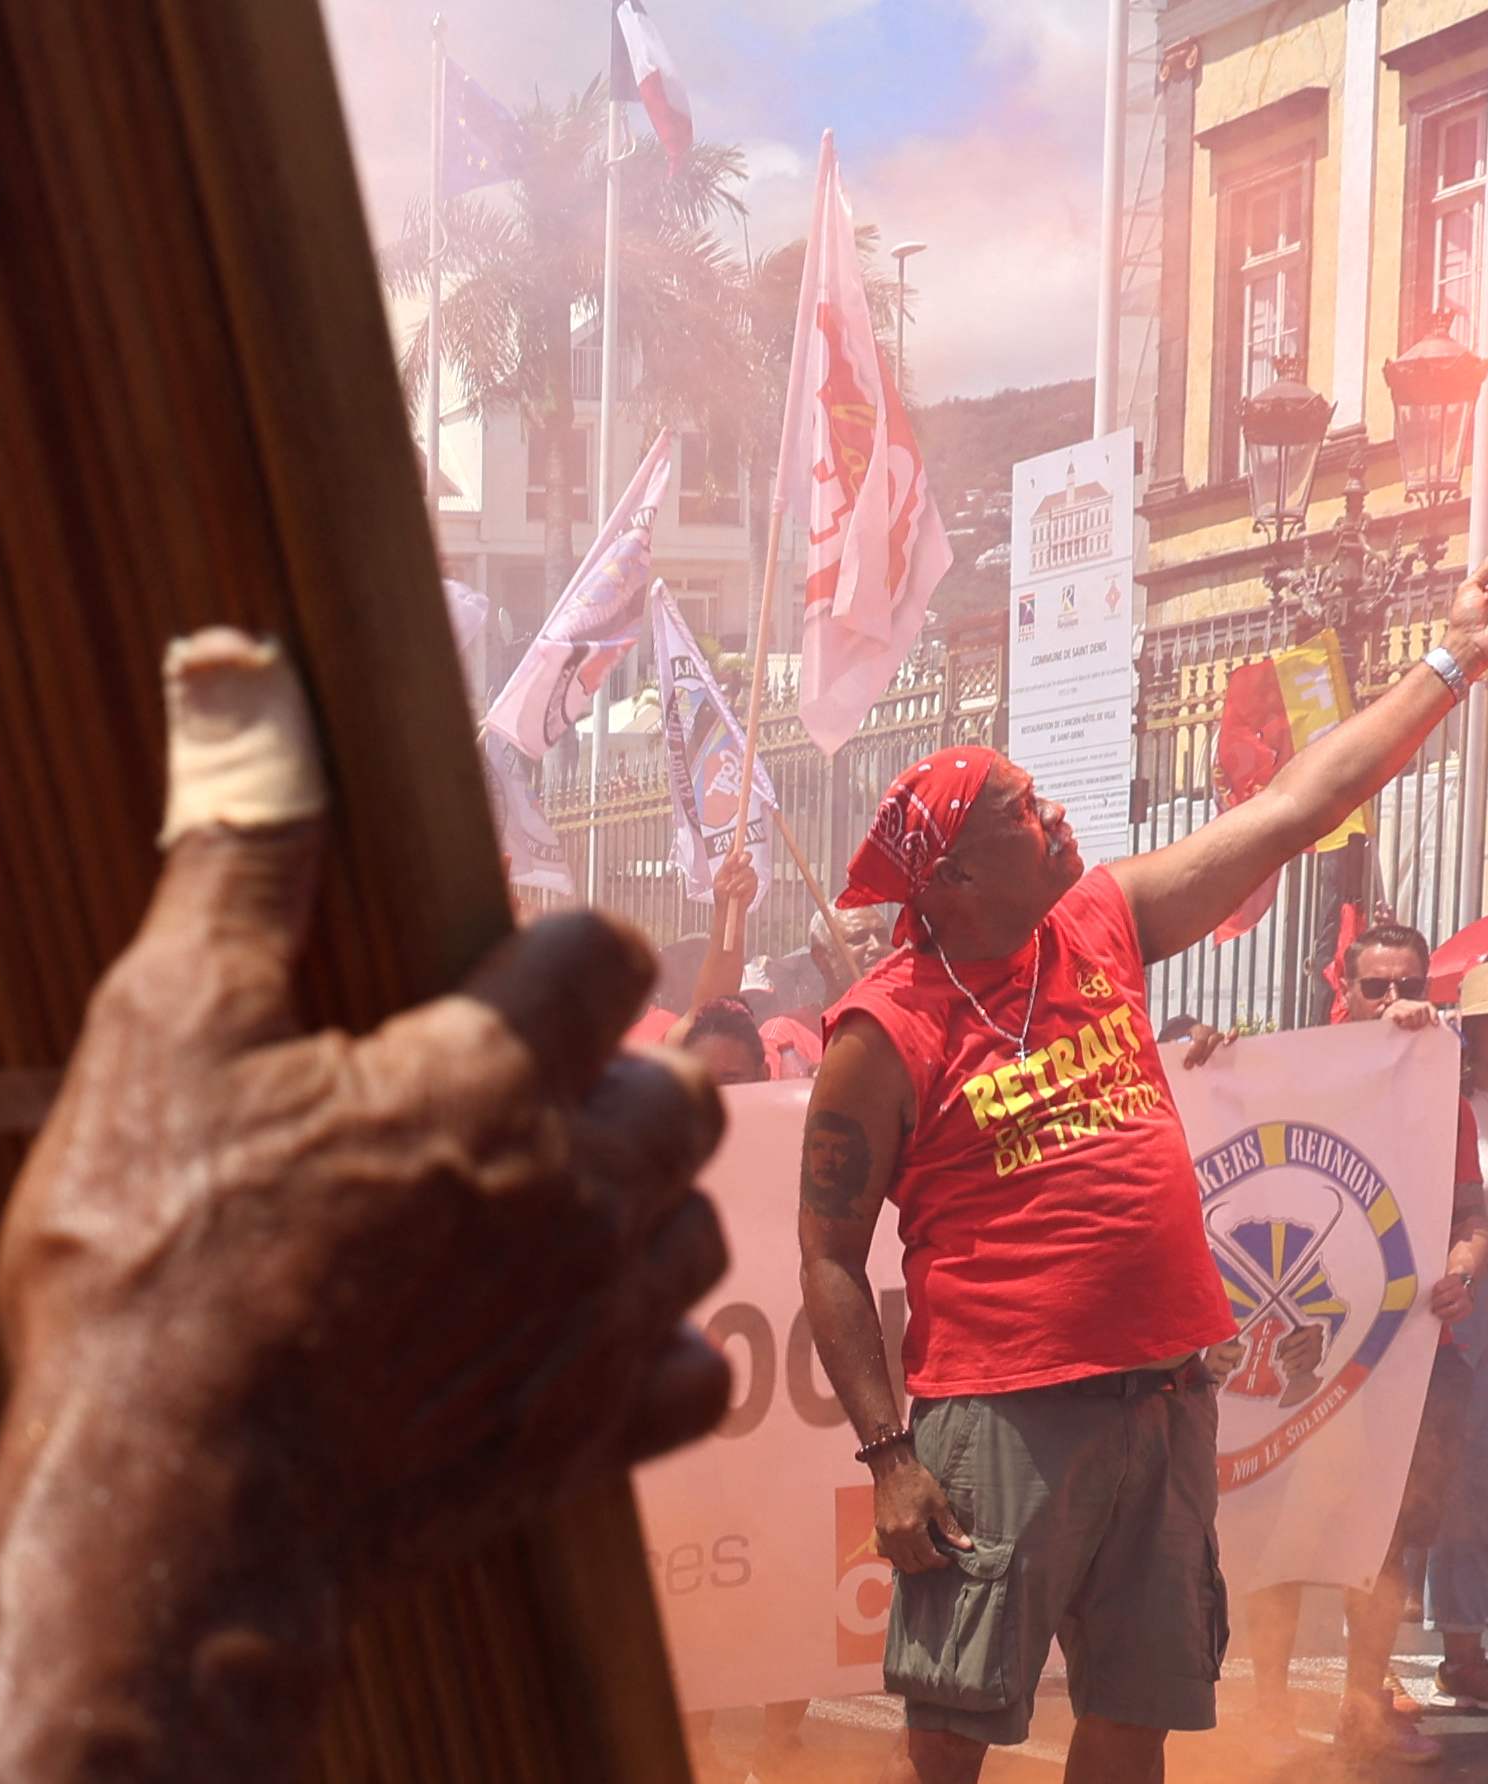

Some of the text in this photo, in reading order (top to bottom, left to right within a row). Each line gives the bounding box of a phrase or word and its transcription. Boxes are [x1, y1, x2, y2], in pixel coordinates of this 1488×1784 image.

[1064, 648, 1071, 660] DE
[1072, 645, 1089, 657] SAINT
[962, 1003, 1141, 1131] RETRAIT
[993, 1080, 1162, 1178] DU TRAVAIL
[996, 1109, 1040, 1148] DE
[1194, 1126, 1382, 1207] KERS REUNION
